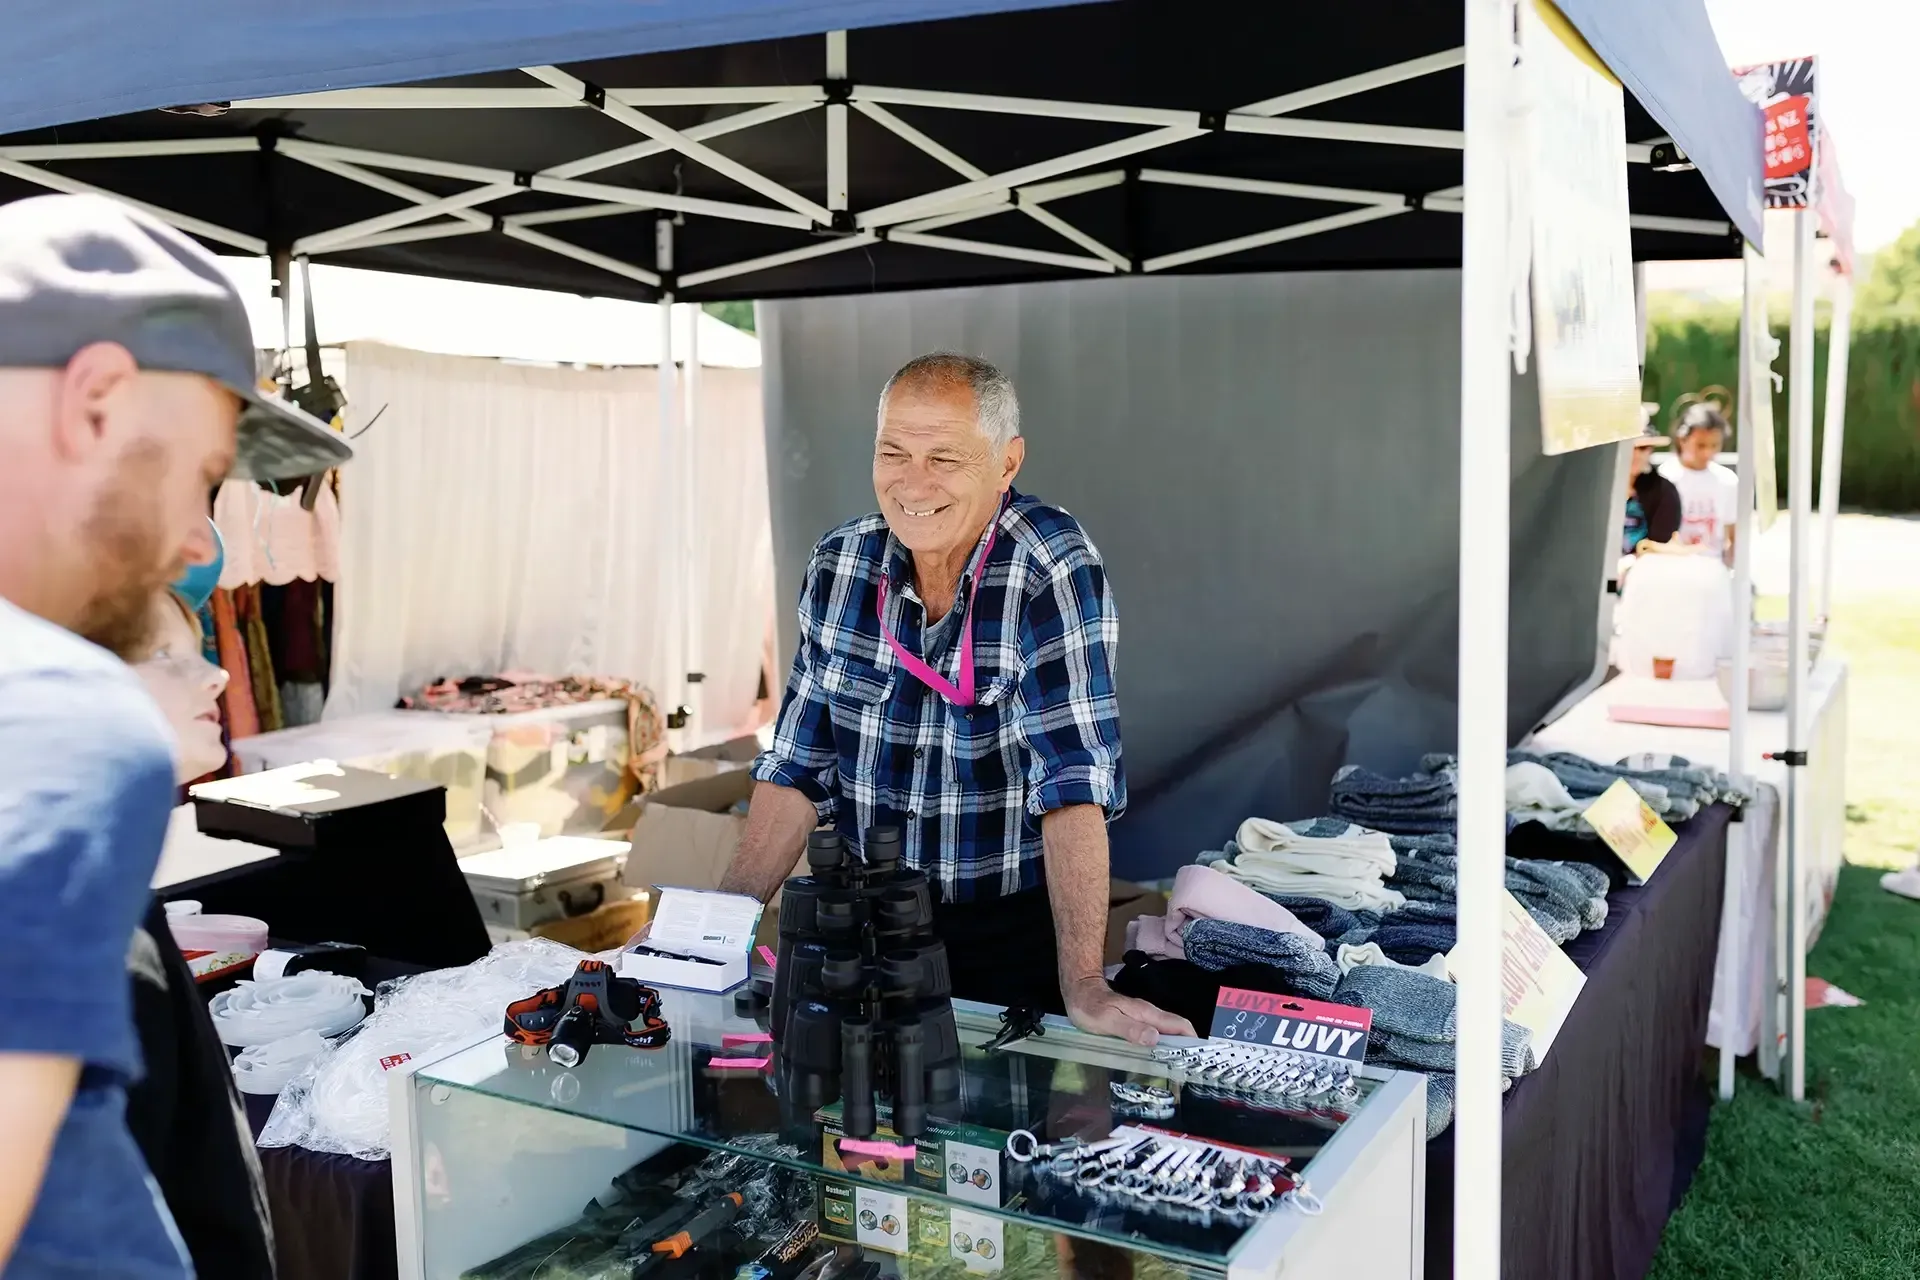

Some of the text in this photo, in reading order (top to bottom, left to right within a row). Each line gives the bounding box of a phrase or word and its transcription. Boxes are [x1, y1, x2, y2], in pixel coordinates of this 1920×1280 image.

[1221, 991, 1282, 1013] LUVY
[1315, 1014, 1334, 1023] MADE
[1343, 1019, 1364, 1028] CHINA
[1271, 1018, 1364, 1057] LUVY
[926, 1125, 956, 1137] shnell
[914, 1136, 940, 1150] Bushnell
[825, 1184, 850, 1197] Bushnell
